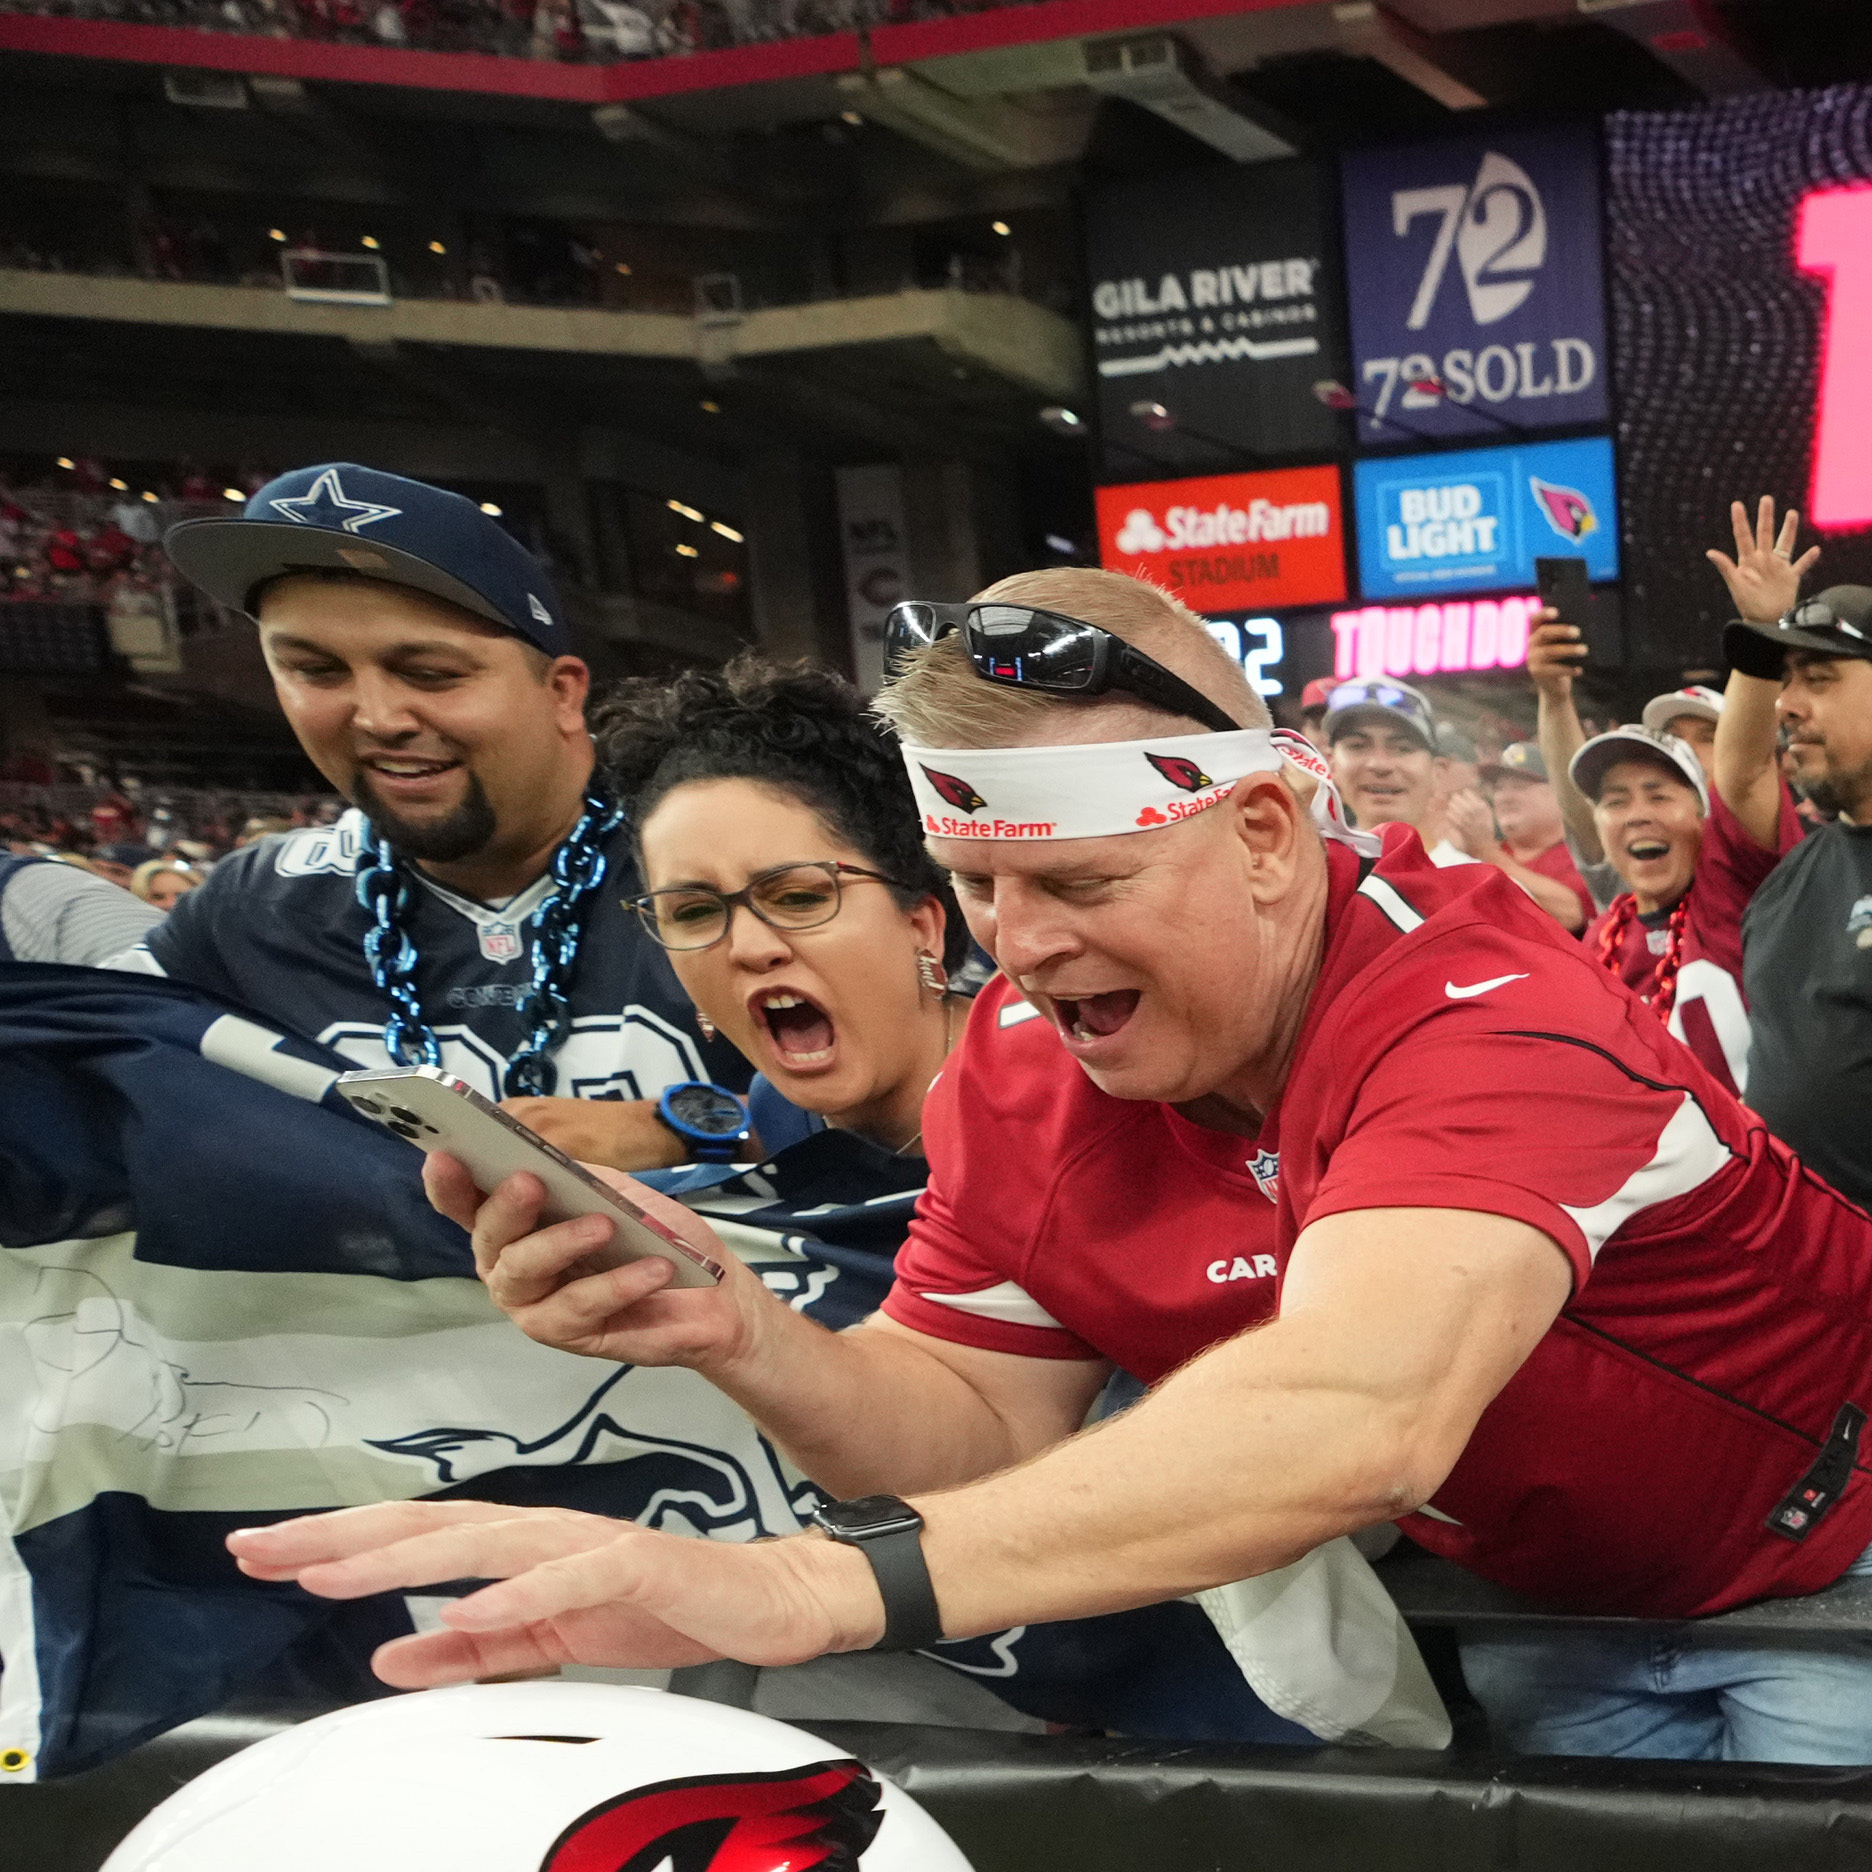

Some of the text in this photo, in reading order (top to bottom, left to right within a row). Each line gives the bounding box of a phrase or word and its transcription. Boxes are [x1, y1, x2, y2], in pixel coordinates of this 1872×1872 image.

[1093, 258, 1314, 320] GILA RIVER
[1401, 484, 1482, 522] BUD
[1387, 515, 1498, 561] LIGHT
[1170, 552, 1280, 589] STADIUM
[1206, 1253, 1278, 1284] CAR
